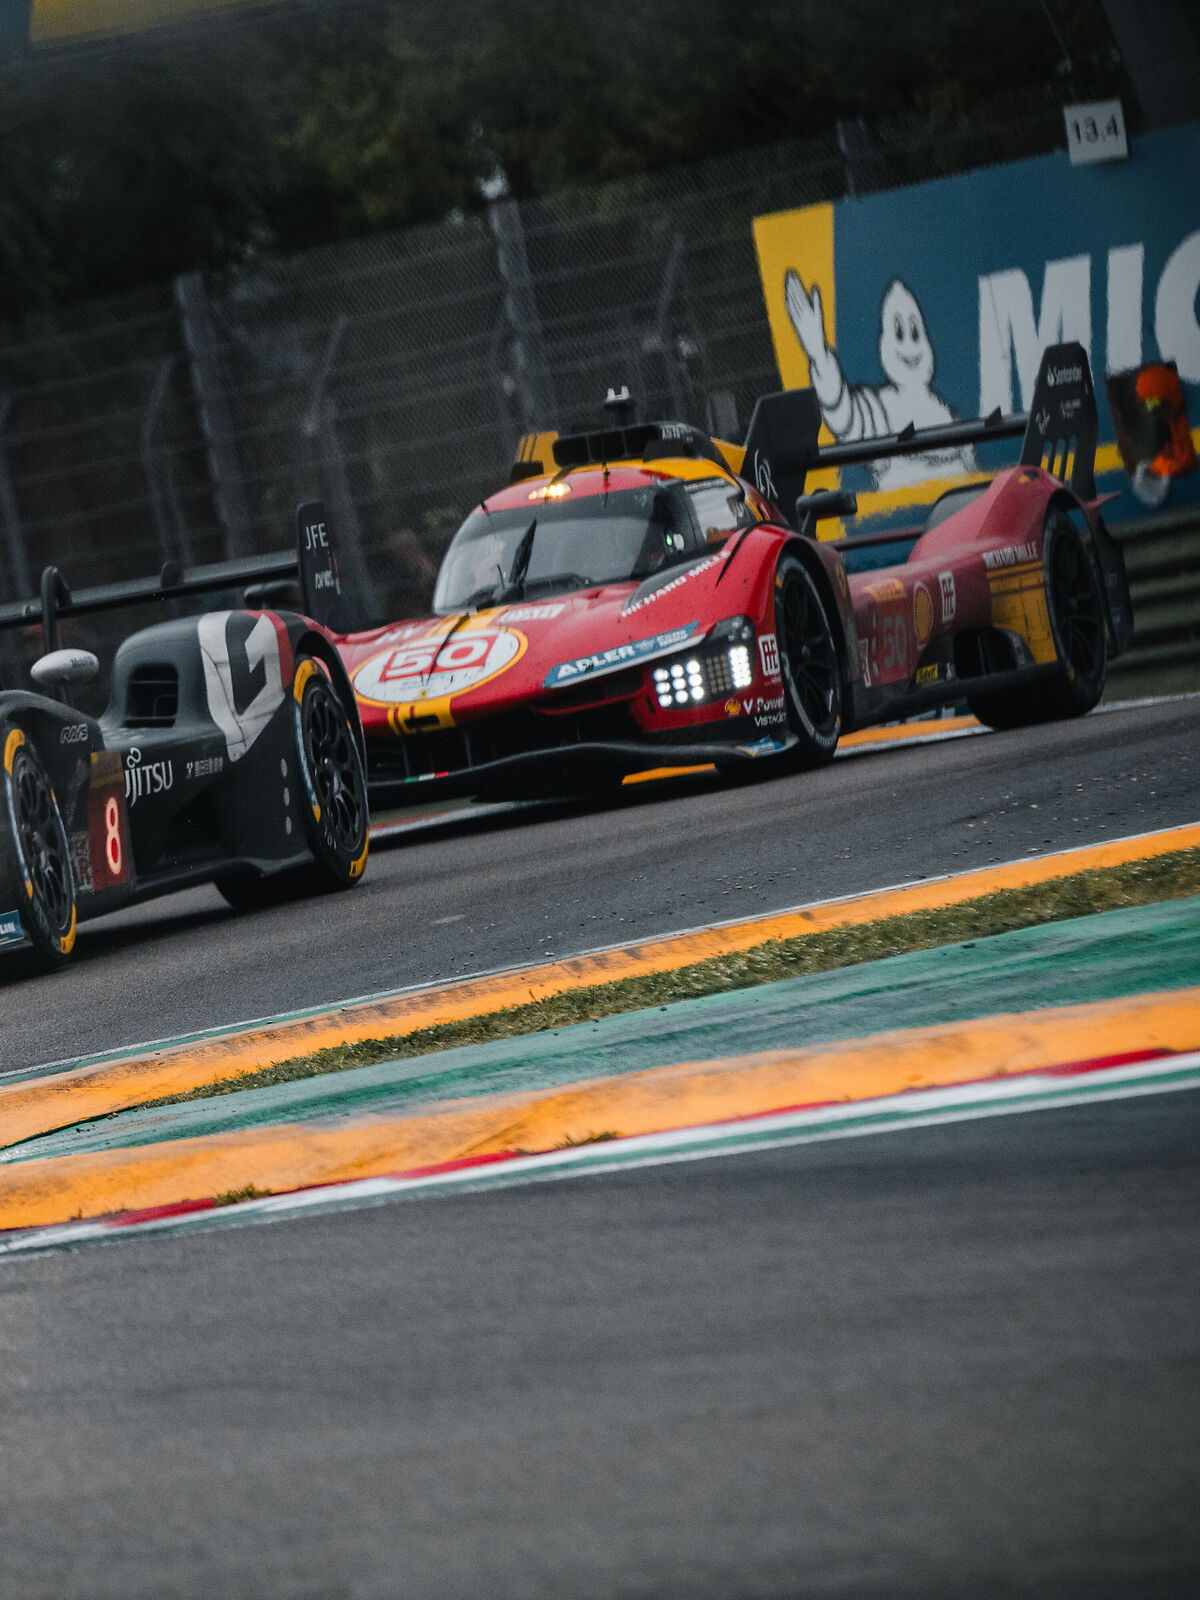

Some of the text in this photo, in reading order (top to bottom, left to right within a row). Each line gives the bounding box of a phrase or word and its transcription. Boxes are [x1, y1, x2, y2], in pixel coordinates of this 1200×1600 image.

[305, 522, 329, 551] JFE
[385, 638, 490, 678] 50
[557, 644, 636, 679] ADLER
[883, 614, 907, 669] 50
[105, 796, 122, 876] 8
